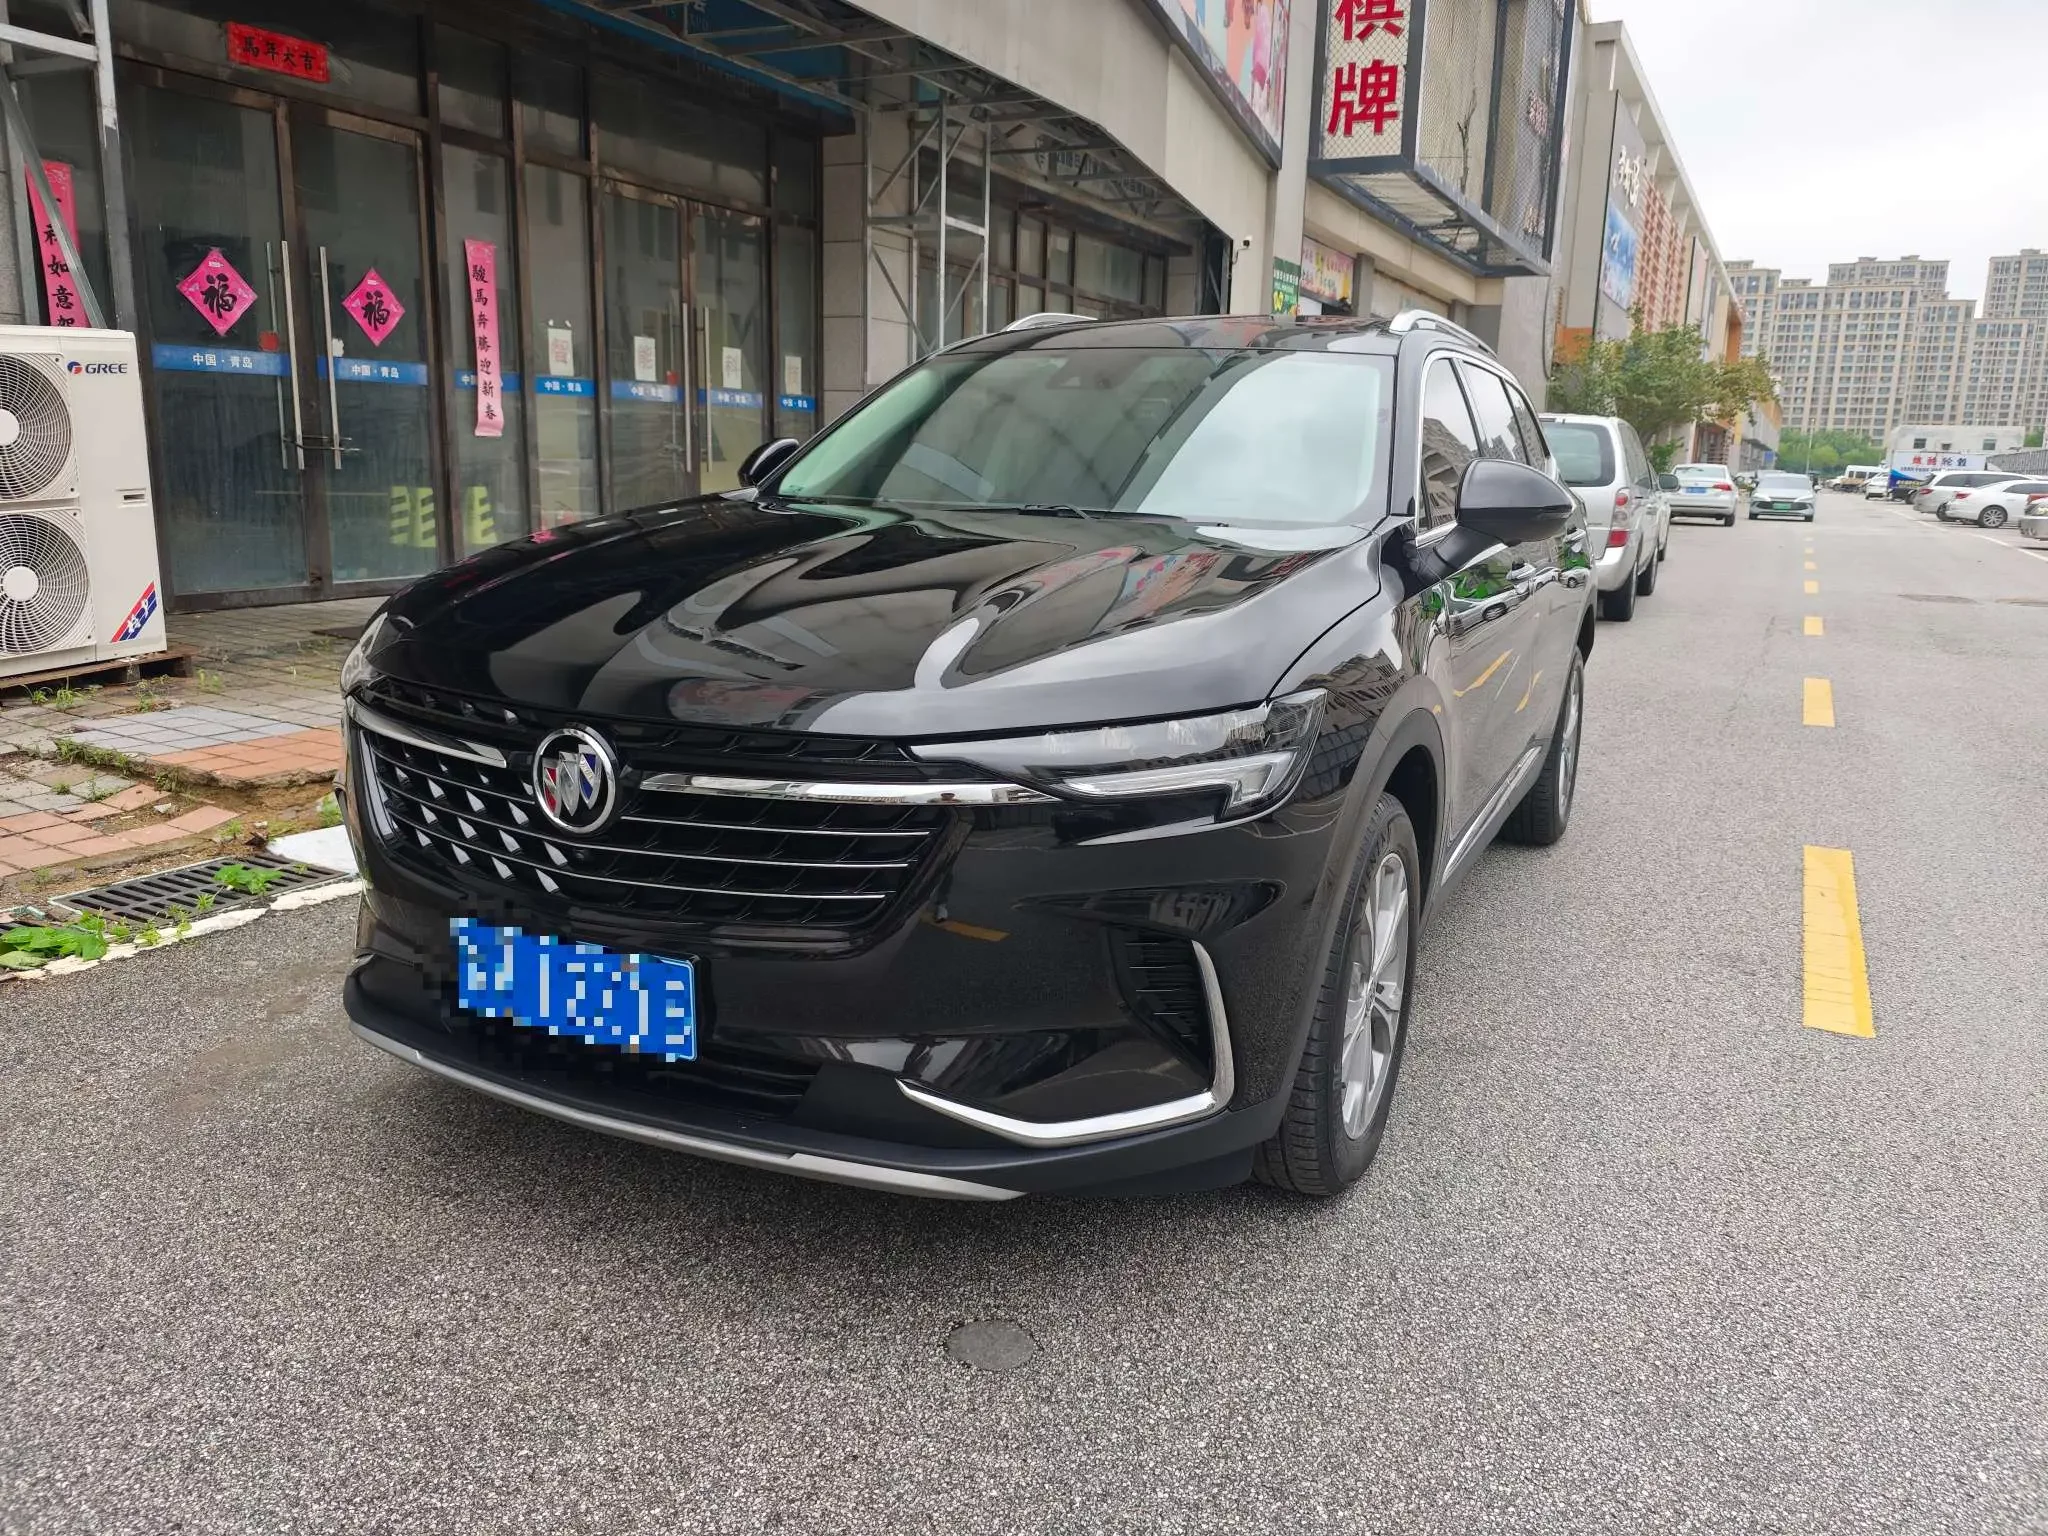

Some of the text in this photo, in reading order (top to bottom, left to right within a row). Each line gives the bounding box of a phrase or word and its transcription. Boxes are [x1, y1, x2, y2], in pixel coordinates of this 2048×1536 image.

[242, 35, 317, 71] 馬年大吉
[200, 272, 238, 319] 福
[361, 290, 391, 331] 福
[85, 363, 128, 374] GREE
